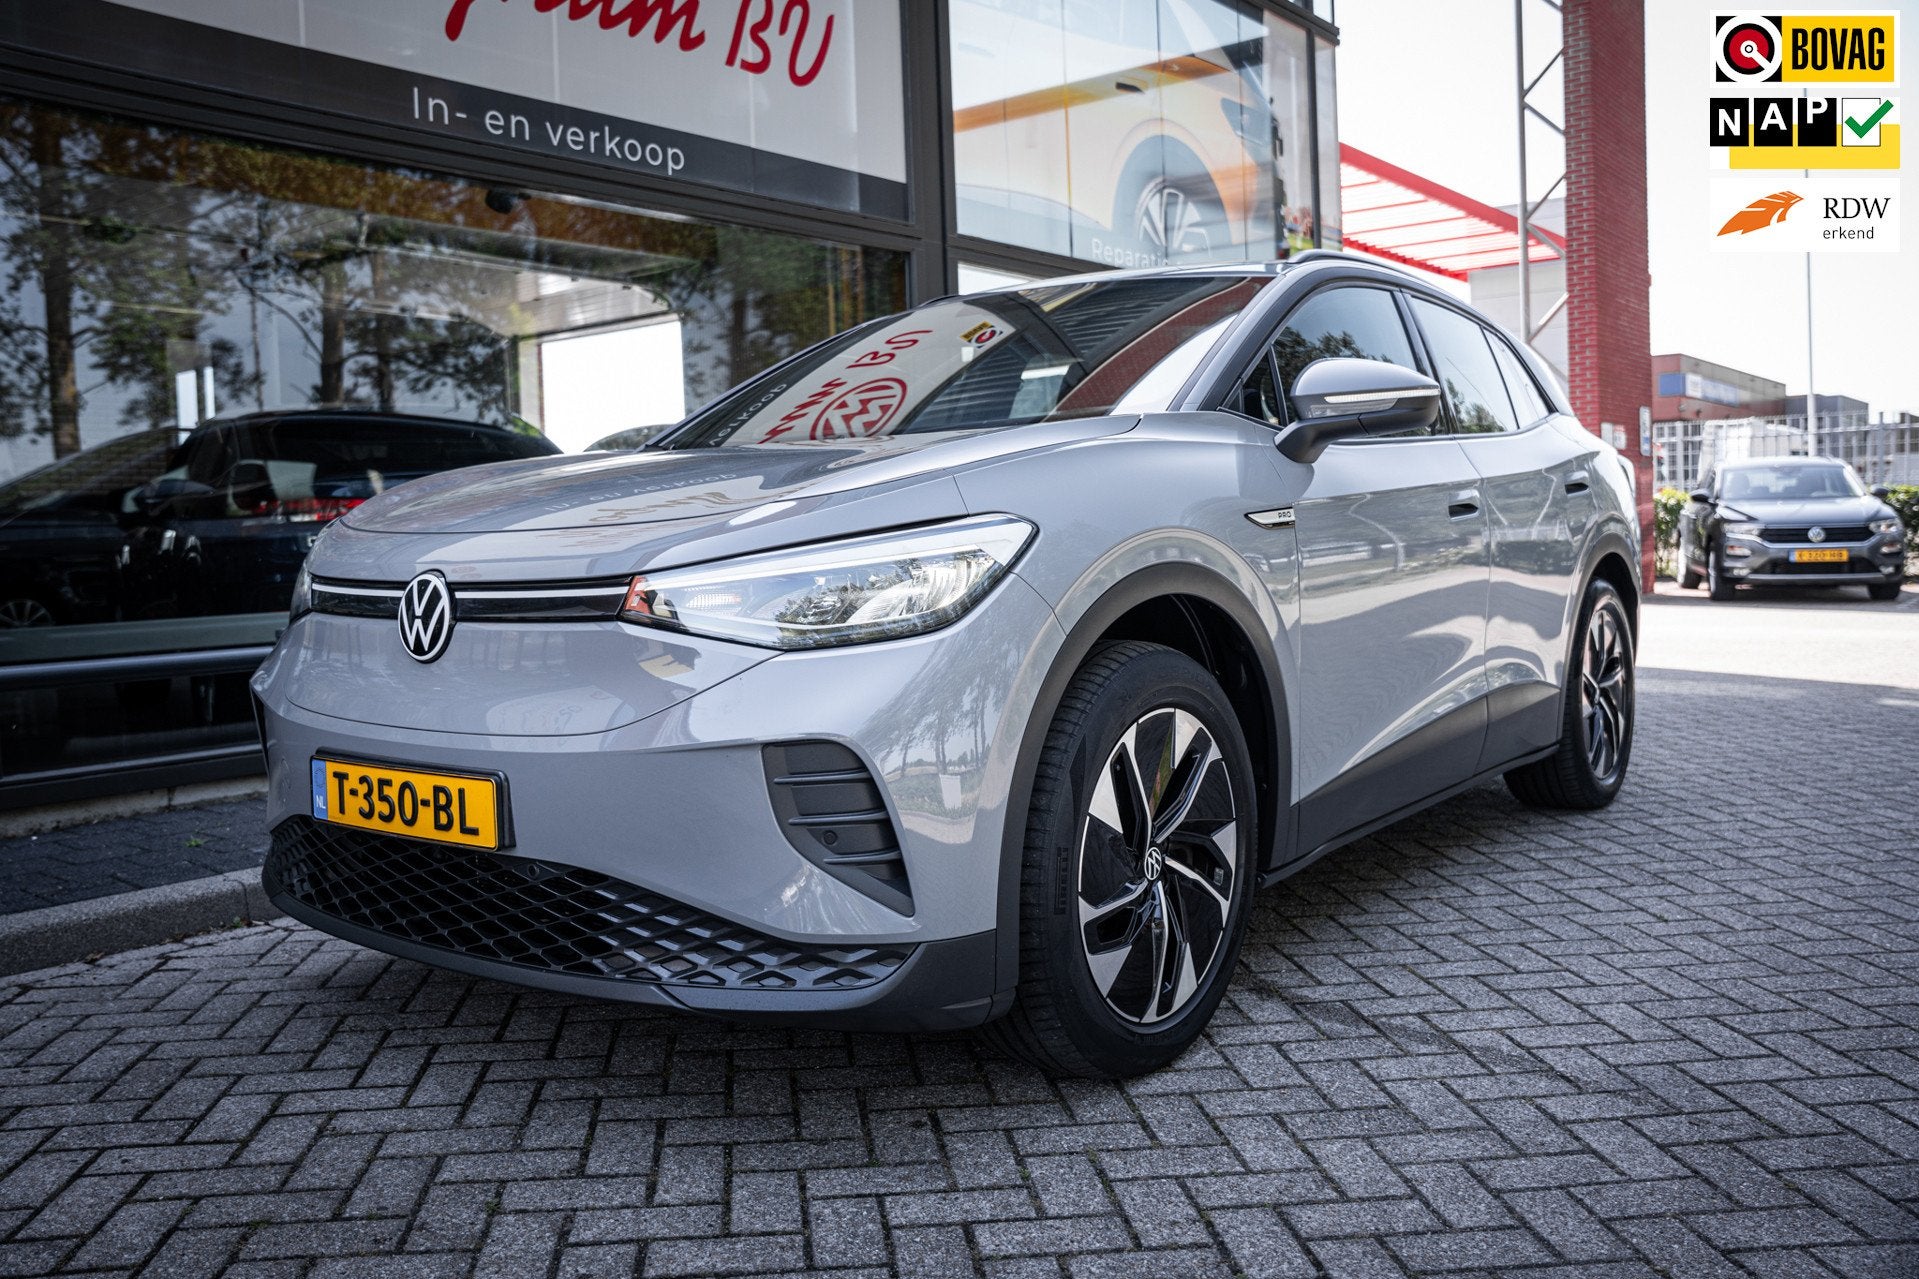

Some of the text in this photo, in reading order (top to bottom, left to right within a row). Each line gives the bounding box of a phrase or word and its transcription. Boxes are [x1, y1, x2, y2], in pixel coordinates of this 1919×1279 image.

[412, 86, 685, 175] In- en verkoop
[315, 795, 326, 809] NL
[332, 770, 480, 837] T-350-BL
